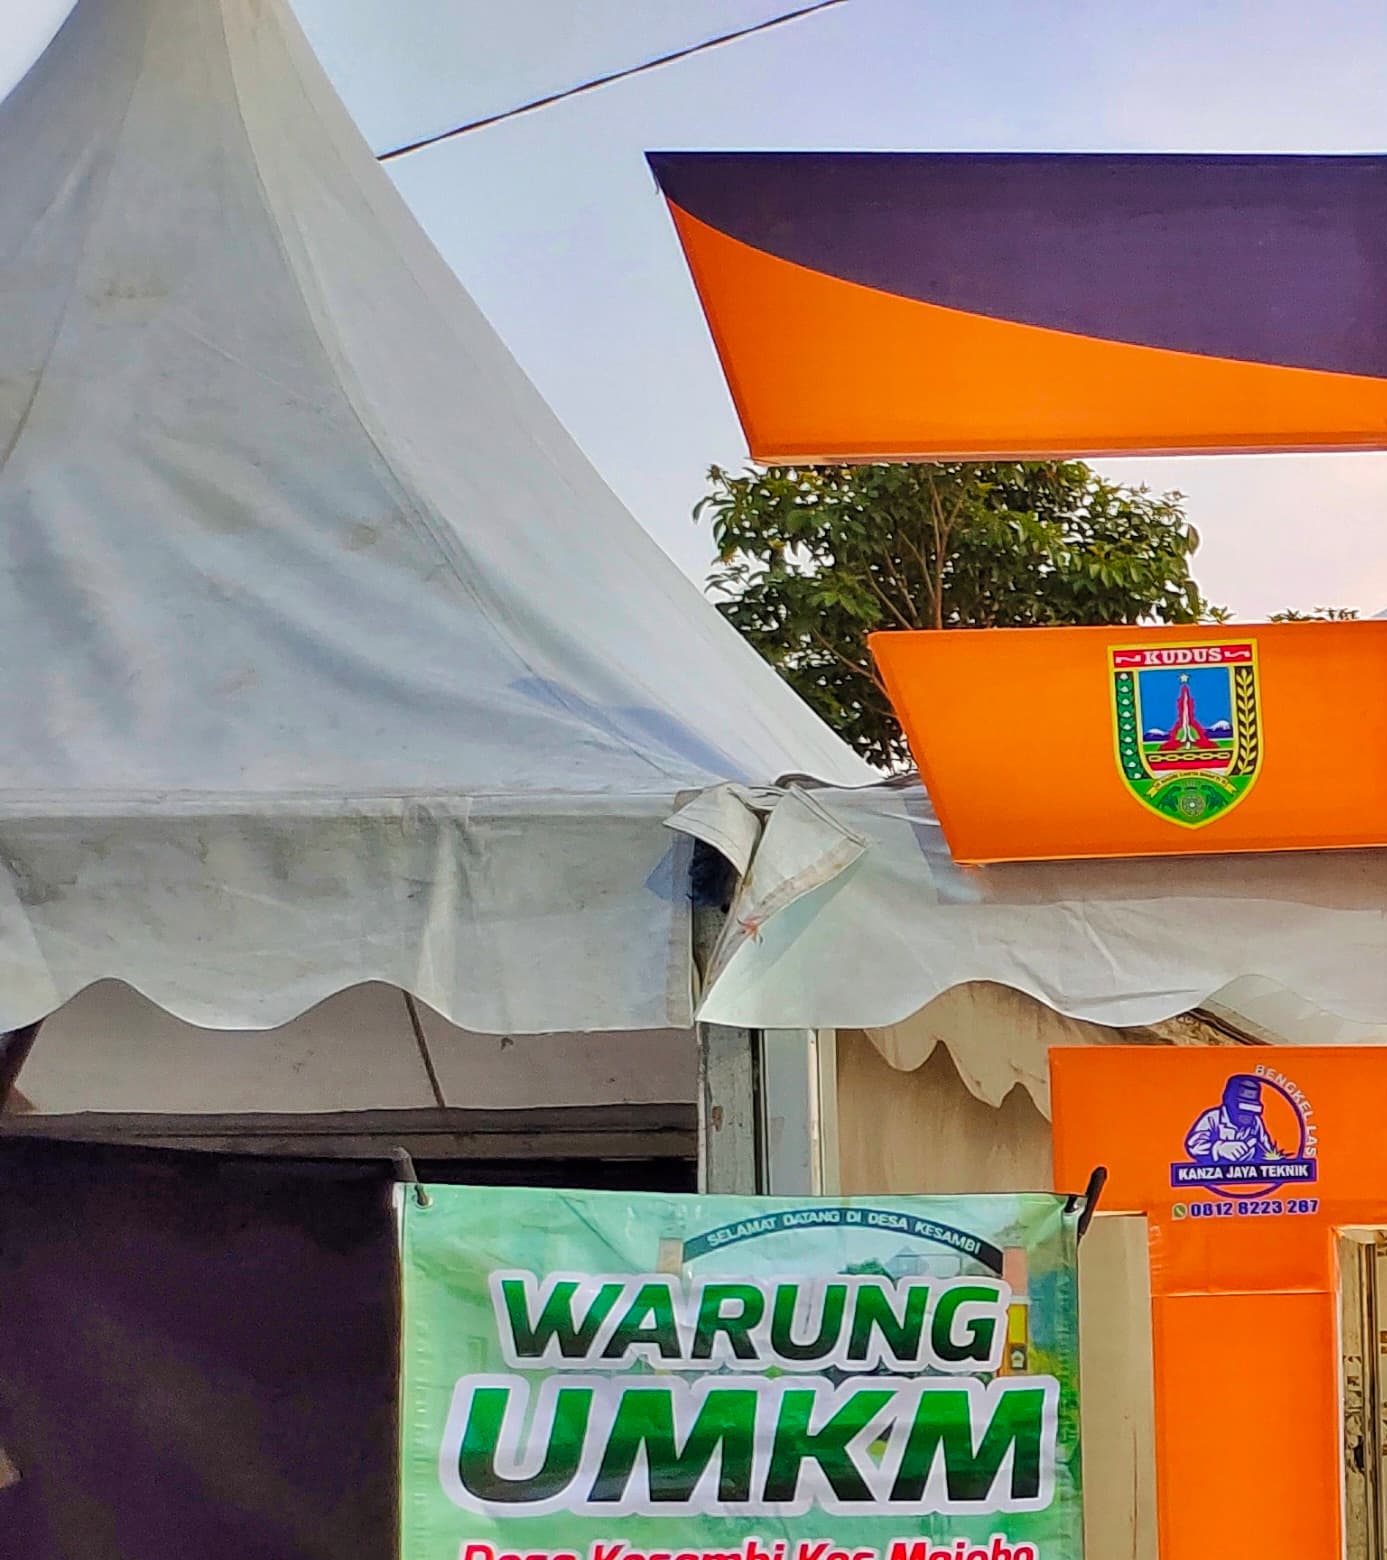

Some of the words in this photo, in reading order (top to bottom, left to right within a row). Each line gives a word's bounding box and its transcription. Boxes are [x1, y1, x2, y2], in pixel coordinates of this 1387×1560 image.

[1143, 648, 1223, 665] KUDUS
[1254, 1064, 1314, 1121] BENGKEL
[1304, 1124, 1319, 1158] LAS
[1178, 1166, 1223, 1181] KANZA
[1226, 1165, 1258, 1179] JAYA
[1260, 1164, 1309, 1178] TEKNIK
[1190, 1202, 1233, 1217] 0812
[705, 1217, 778, 1248] SELAMAT
[782, 1211, 840, 1227] DATANG
[845, 1210, 862, 1224] DI
[867, 1211, 909, 1230] DESA
[914, 1219, 983, 1255] KESAMBI
[495, 1275, 1005, 1365] WARUNG
[454, 1382, 1049, 1507] UMKM
